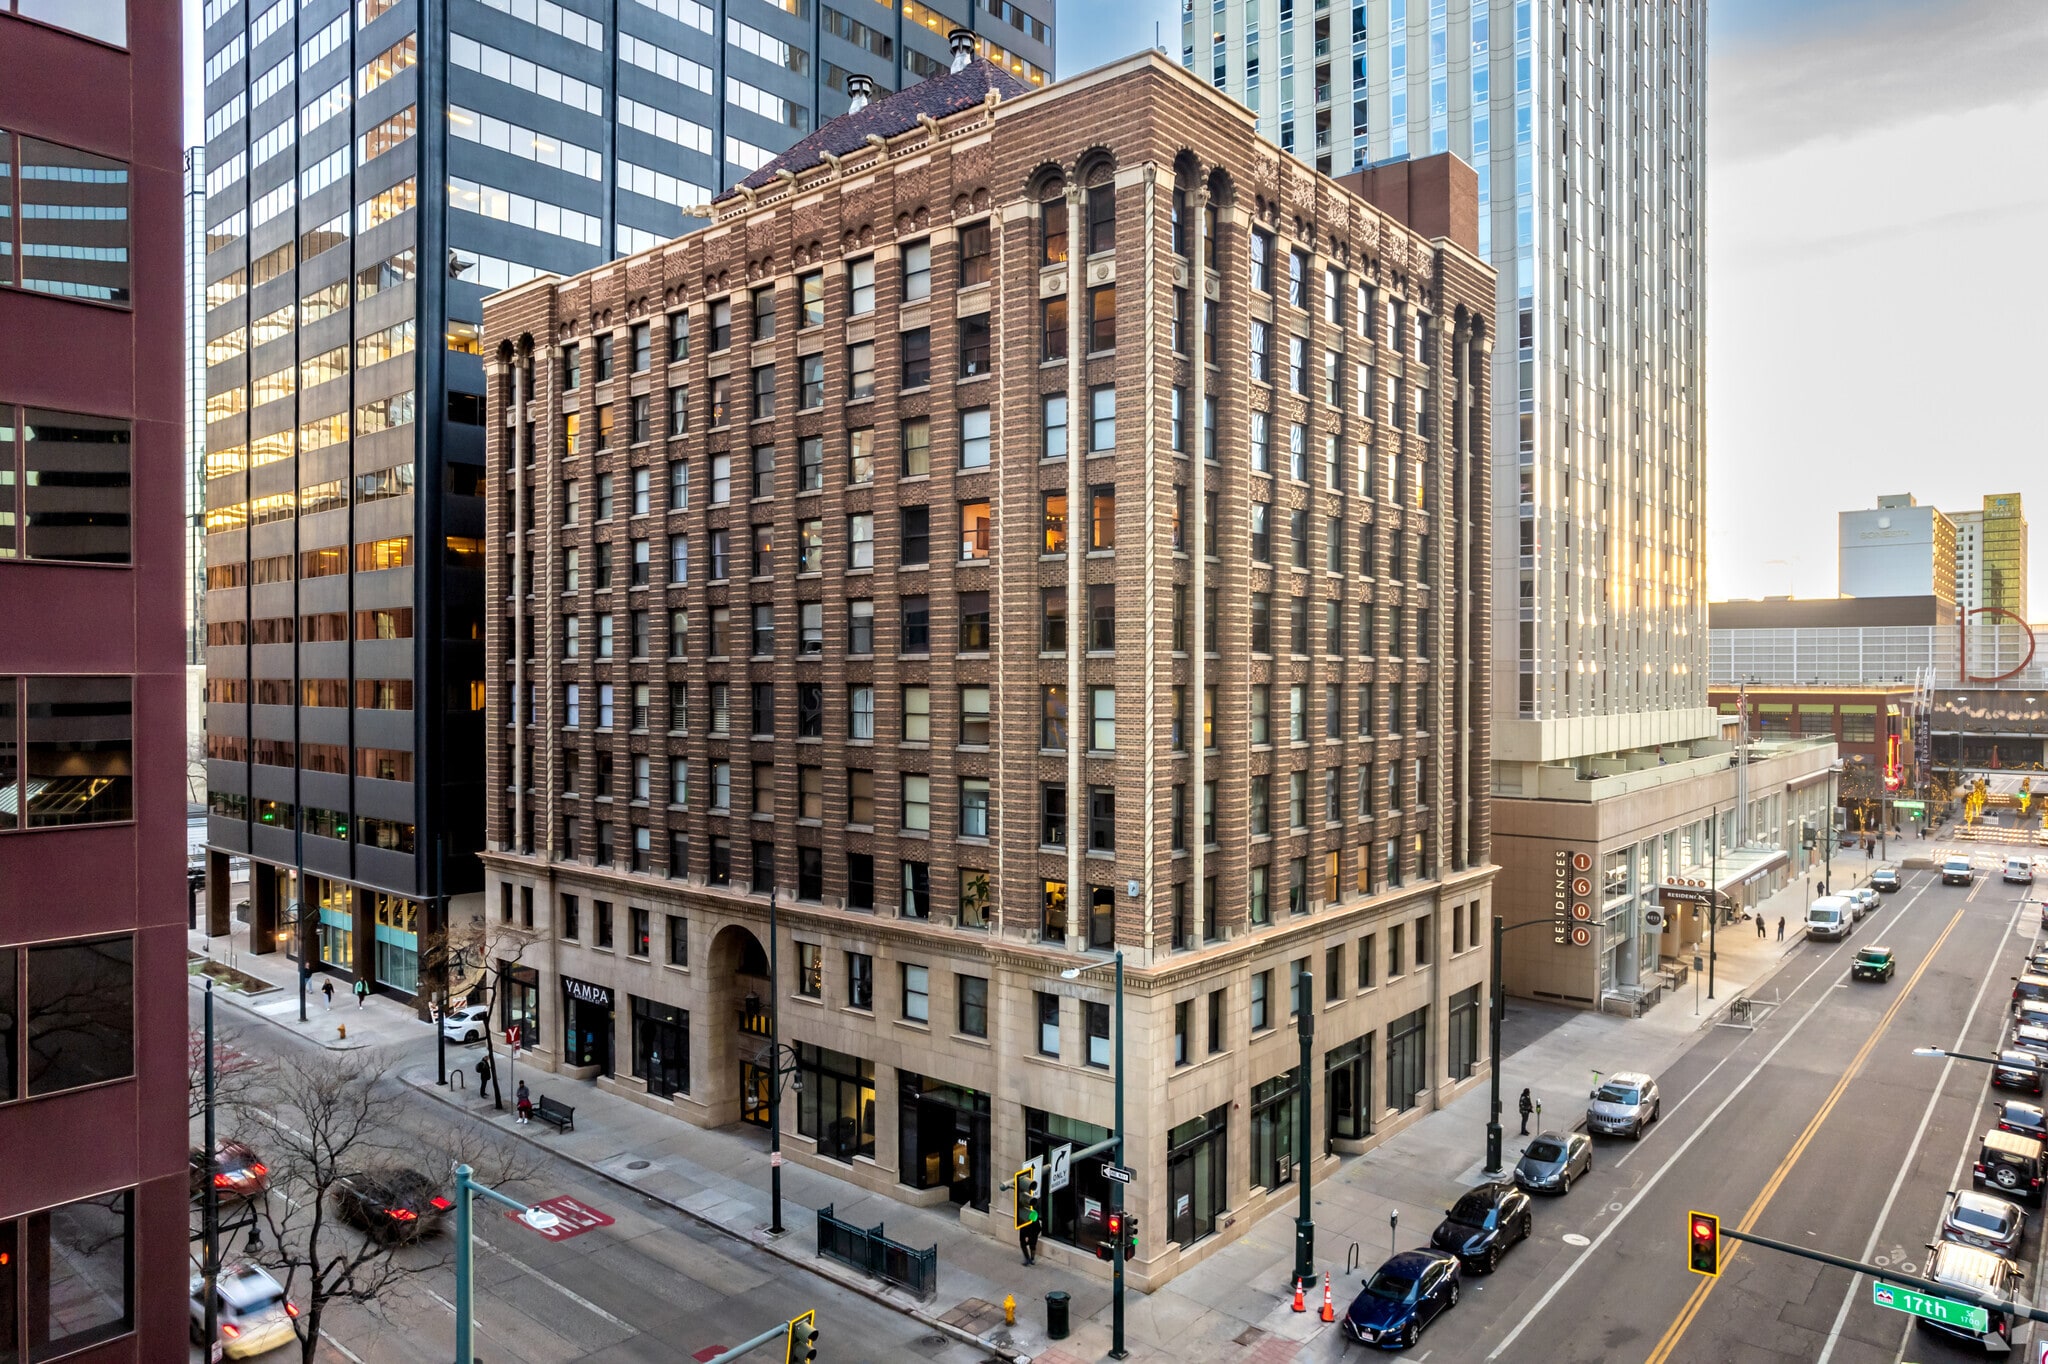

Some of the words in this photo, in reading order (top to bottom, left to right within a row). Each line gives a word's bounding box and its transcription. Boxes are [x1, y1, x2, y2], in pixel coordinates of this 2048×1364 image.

[1554, 850, 1566, 944] RESIDENCES
[566, 980, 608, 1004] YAMPA
[1052, 1170, 1066, 1181] ONLY
[1903, 1295, 1947, 1319] 17th
[1966, 1310, 1974, 1318] St
